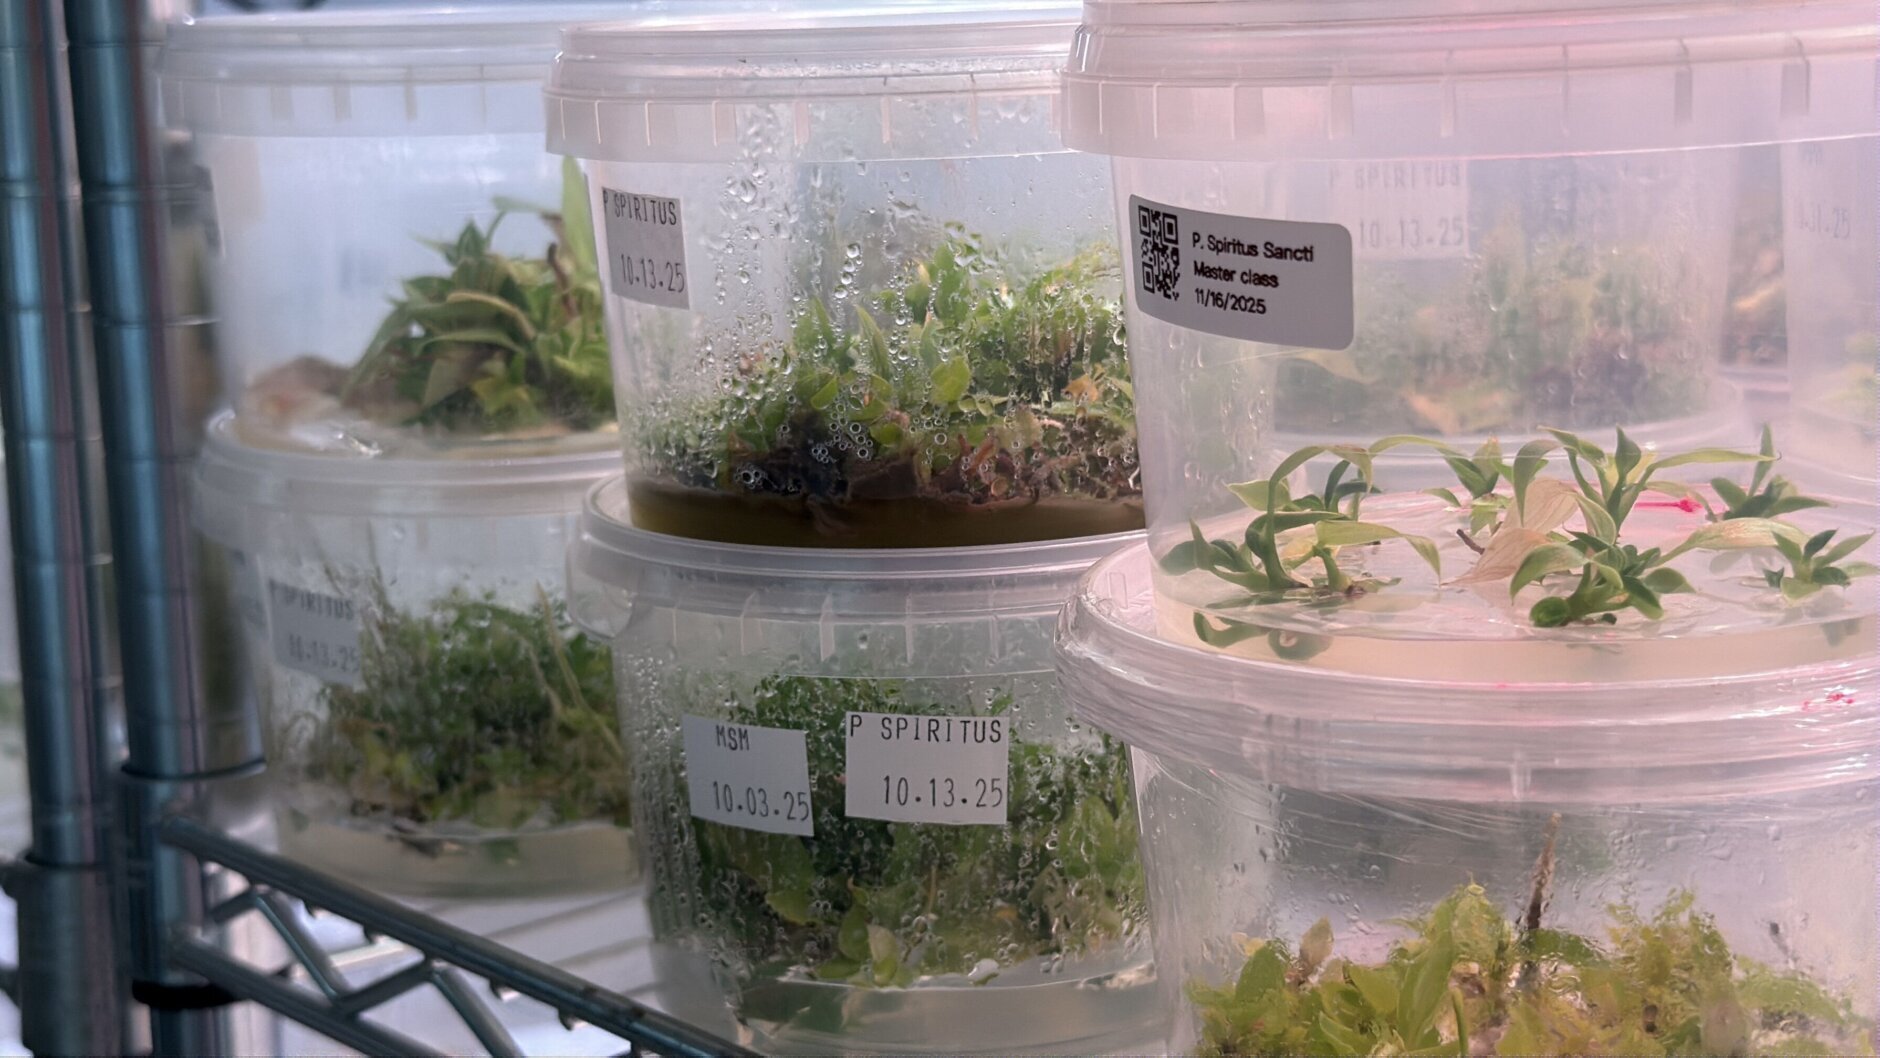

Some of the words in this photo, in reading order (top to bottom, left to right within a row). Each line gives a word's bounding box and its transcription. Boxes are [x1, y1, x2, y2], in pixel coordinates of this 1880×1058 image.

[1355, 162, 1460, 189] SPIRITUS
[614, 193, 677, 225] SPIRITUS
[1192, 232, 1204, 250] P.
[1207, 235, 1259, 258] Spiritus
[1263, 242, 1314, 262] Sancti
[1359, 217, 1465, 249] 10.13.25
[621, 253, 685, 293] 10.13.25
[1194, 261, 1237, 282] Master
[1240, 270, 1279, 288] class
[1195, 288, 1267, 315] 11/16/2025
[716, 724, 750, 751] MSM
[850, 714, 862, 737] P
[881, 716, 1001, 744] SPIRITUS
[713, 780, 810, 822] 10.03.25
[883, 775, 1003, 808] 10.13.25
